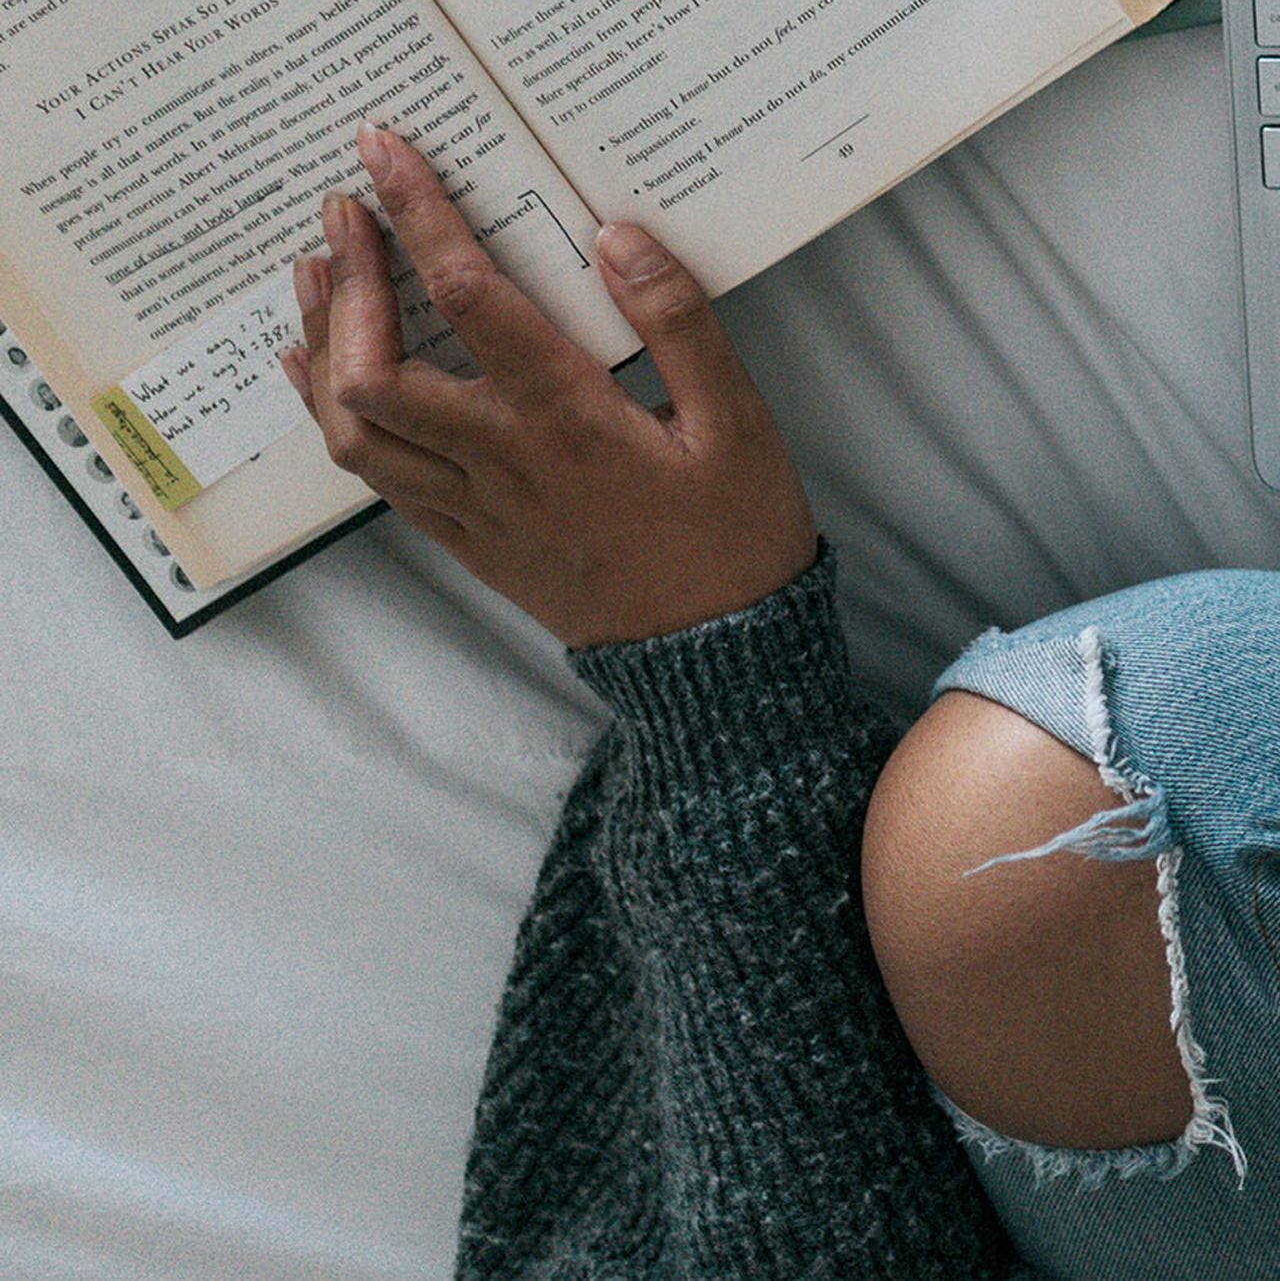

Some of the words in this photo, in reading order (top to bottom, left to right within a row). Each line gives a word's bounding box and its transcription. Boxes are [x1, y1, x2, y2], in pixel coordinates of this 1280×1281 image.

[35, 84, 82, 114] YOUR
[85, 41, 151, 87] ACTIONS
[151, 16, 197, 44] SPEAK
[196, 2, 219, 19] SO
[838, 143, 854, 158] 49
[131, 375, 170, 402] What
[176, 360, 195, 376] we
[206, 337, 241, 355] say
[184, 384, 205, 401] we
[212, 362, 238, 378] say
[161, 415, 194, 441] What
[199, 397, 231, 417] they
[234, 373, 259, 391] see
